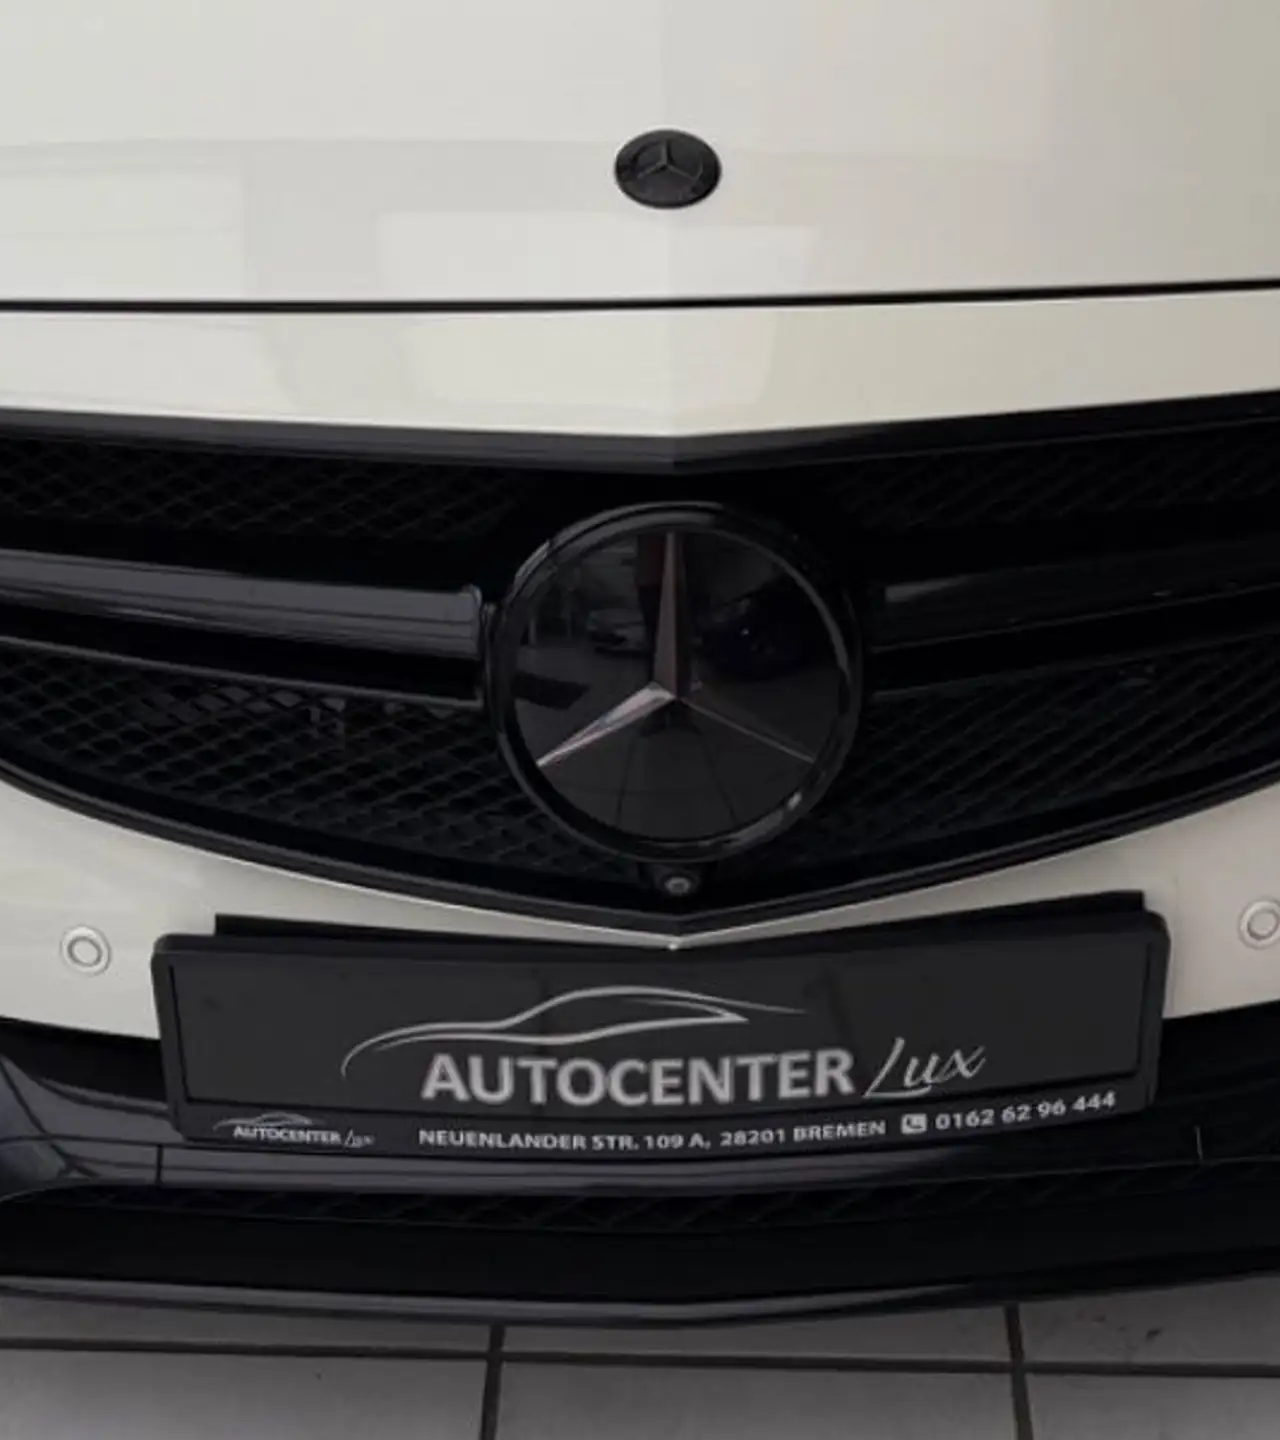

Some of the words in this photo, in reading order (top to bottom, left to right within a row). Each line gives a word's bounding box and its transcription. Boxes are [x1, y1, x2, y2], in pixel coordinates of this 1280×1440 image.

[422, 1047, 854, 1106] AUTOCENTER
[862, 1036, 986, 1099] Lux
[232, 1125, 341, 1146] AUTOCENTER
[418, 1129, 587, 1150] NEUENLANDER
[591, 1134, 639, 1151] STR.
[644, 1133, 684, 1149] 109
[720, 1128, 786, 1147] 28201
[793, 1119, 887, 1143] BREMEN
[934, 1108, 995, 1130] 0162
[1001, 1103, 1032, 1124] 62
[1037, 1098, 1067, 1119] 96
[1071, 1089, 1117, 1112] 444
